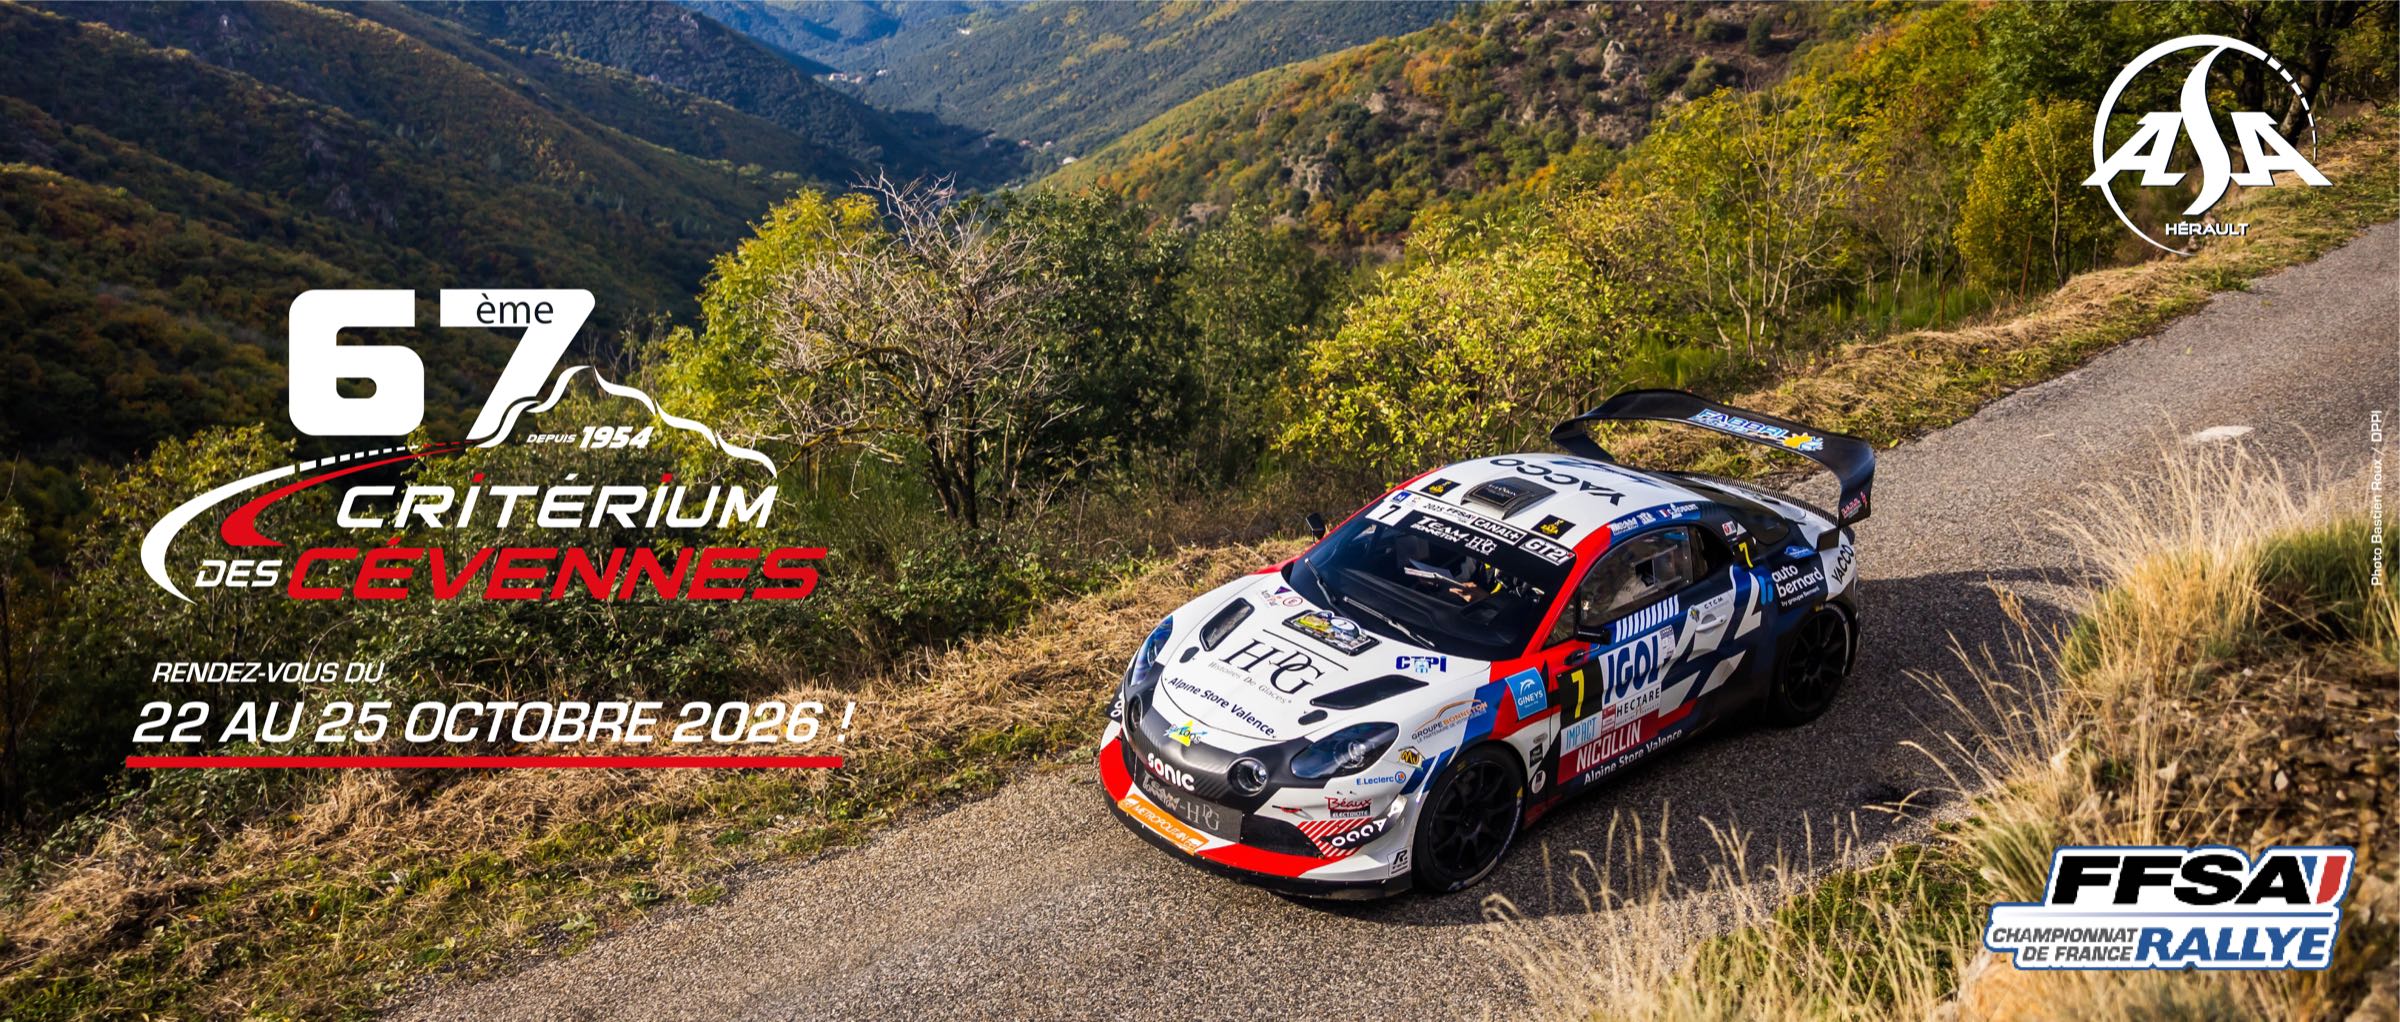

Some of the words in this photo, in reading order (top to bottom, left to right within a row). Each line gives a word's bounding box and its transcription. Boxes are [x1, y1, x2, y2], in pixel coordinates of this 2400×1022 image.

[1379, 504, 1401, 520] 7
[1474, 517, 1521, 544] CANAL+
[1738, 542, 1753, 568] 7
[1831, 544, 1855, 585] YACCO
[1771, 565, 1798, 583] auto
[1775, 567, 1824, 597] bernard
[1168, 677, 1201, 696] Alpine
[1200, 689, 1230, 709] Store
[1231, 703, 1275, 738] Valence
[1517, 691, 1543, 706] GINEYS
[1571, 669, 1584, 719] 7
[1616, 688, 1660, 718] HECTARE
[1411, 721, 1443, 740] GROUPE
[1575, 719, 1643, 773] NICOLLIN
[1583, 762, 1617, 786] Alpine
[1618, 748, 1645, 769] Store
[1646, 728, 1683, 753] Valence
[1356, 775, 1394, 786] E.Leclerc
